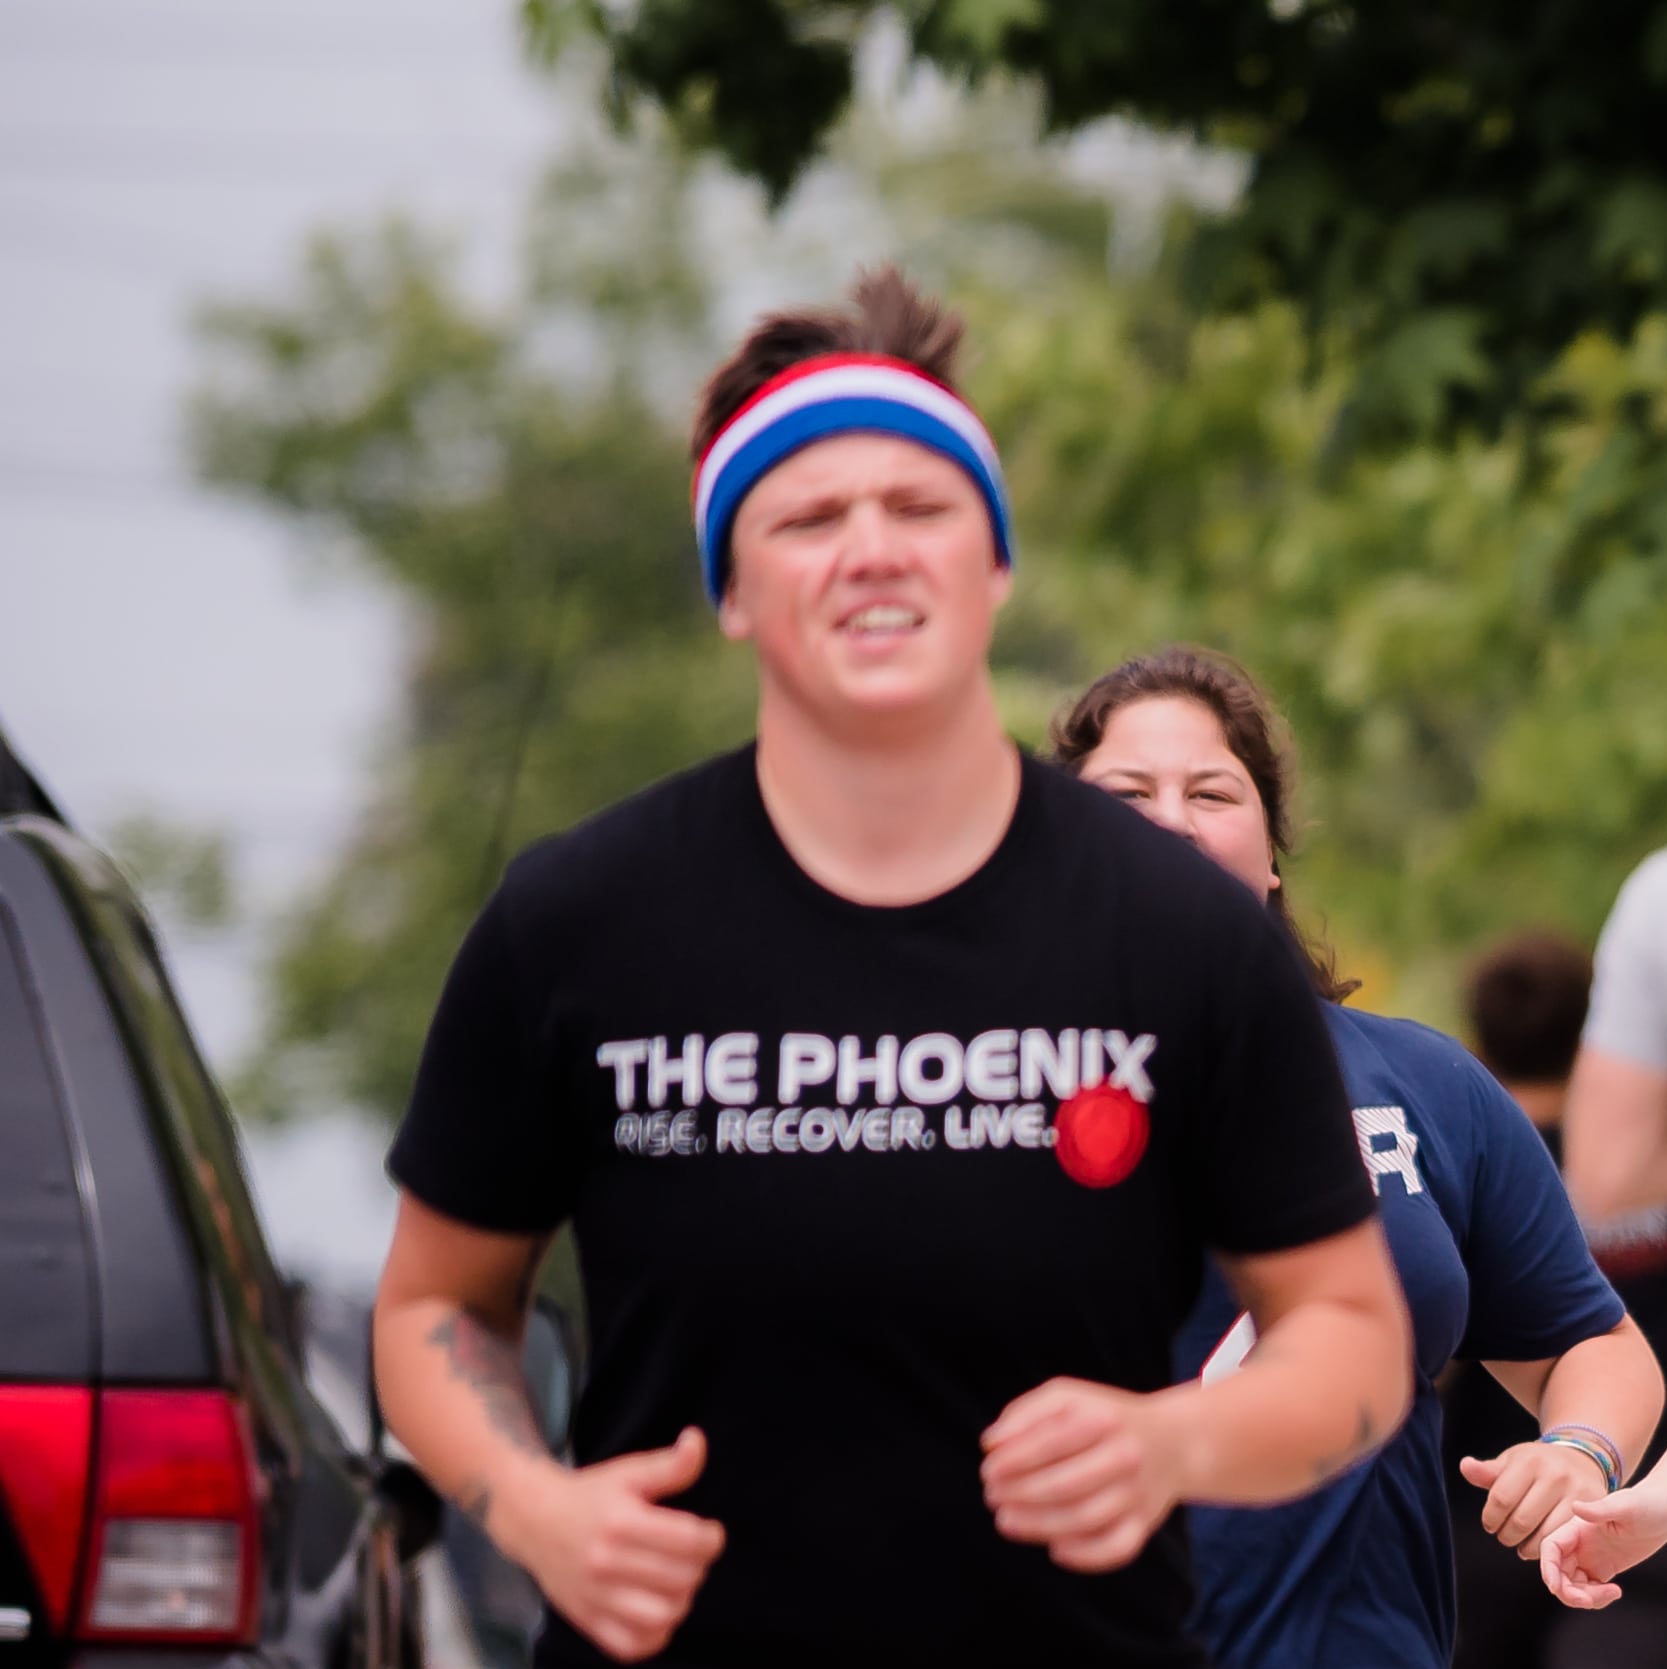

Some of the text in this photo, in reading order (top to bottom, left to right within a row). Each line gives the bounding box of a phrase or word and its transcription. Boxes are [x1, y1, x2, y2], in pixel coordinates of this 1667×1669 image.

[597, 1028, 1157, 1110] THE PHOENIX
[614, 1103, 1059, 1156] RISE. RECOVER. LIVE.
